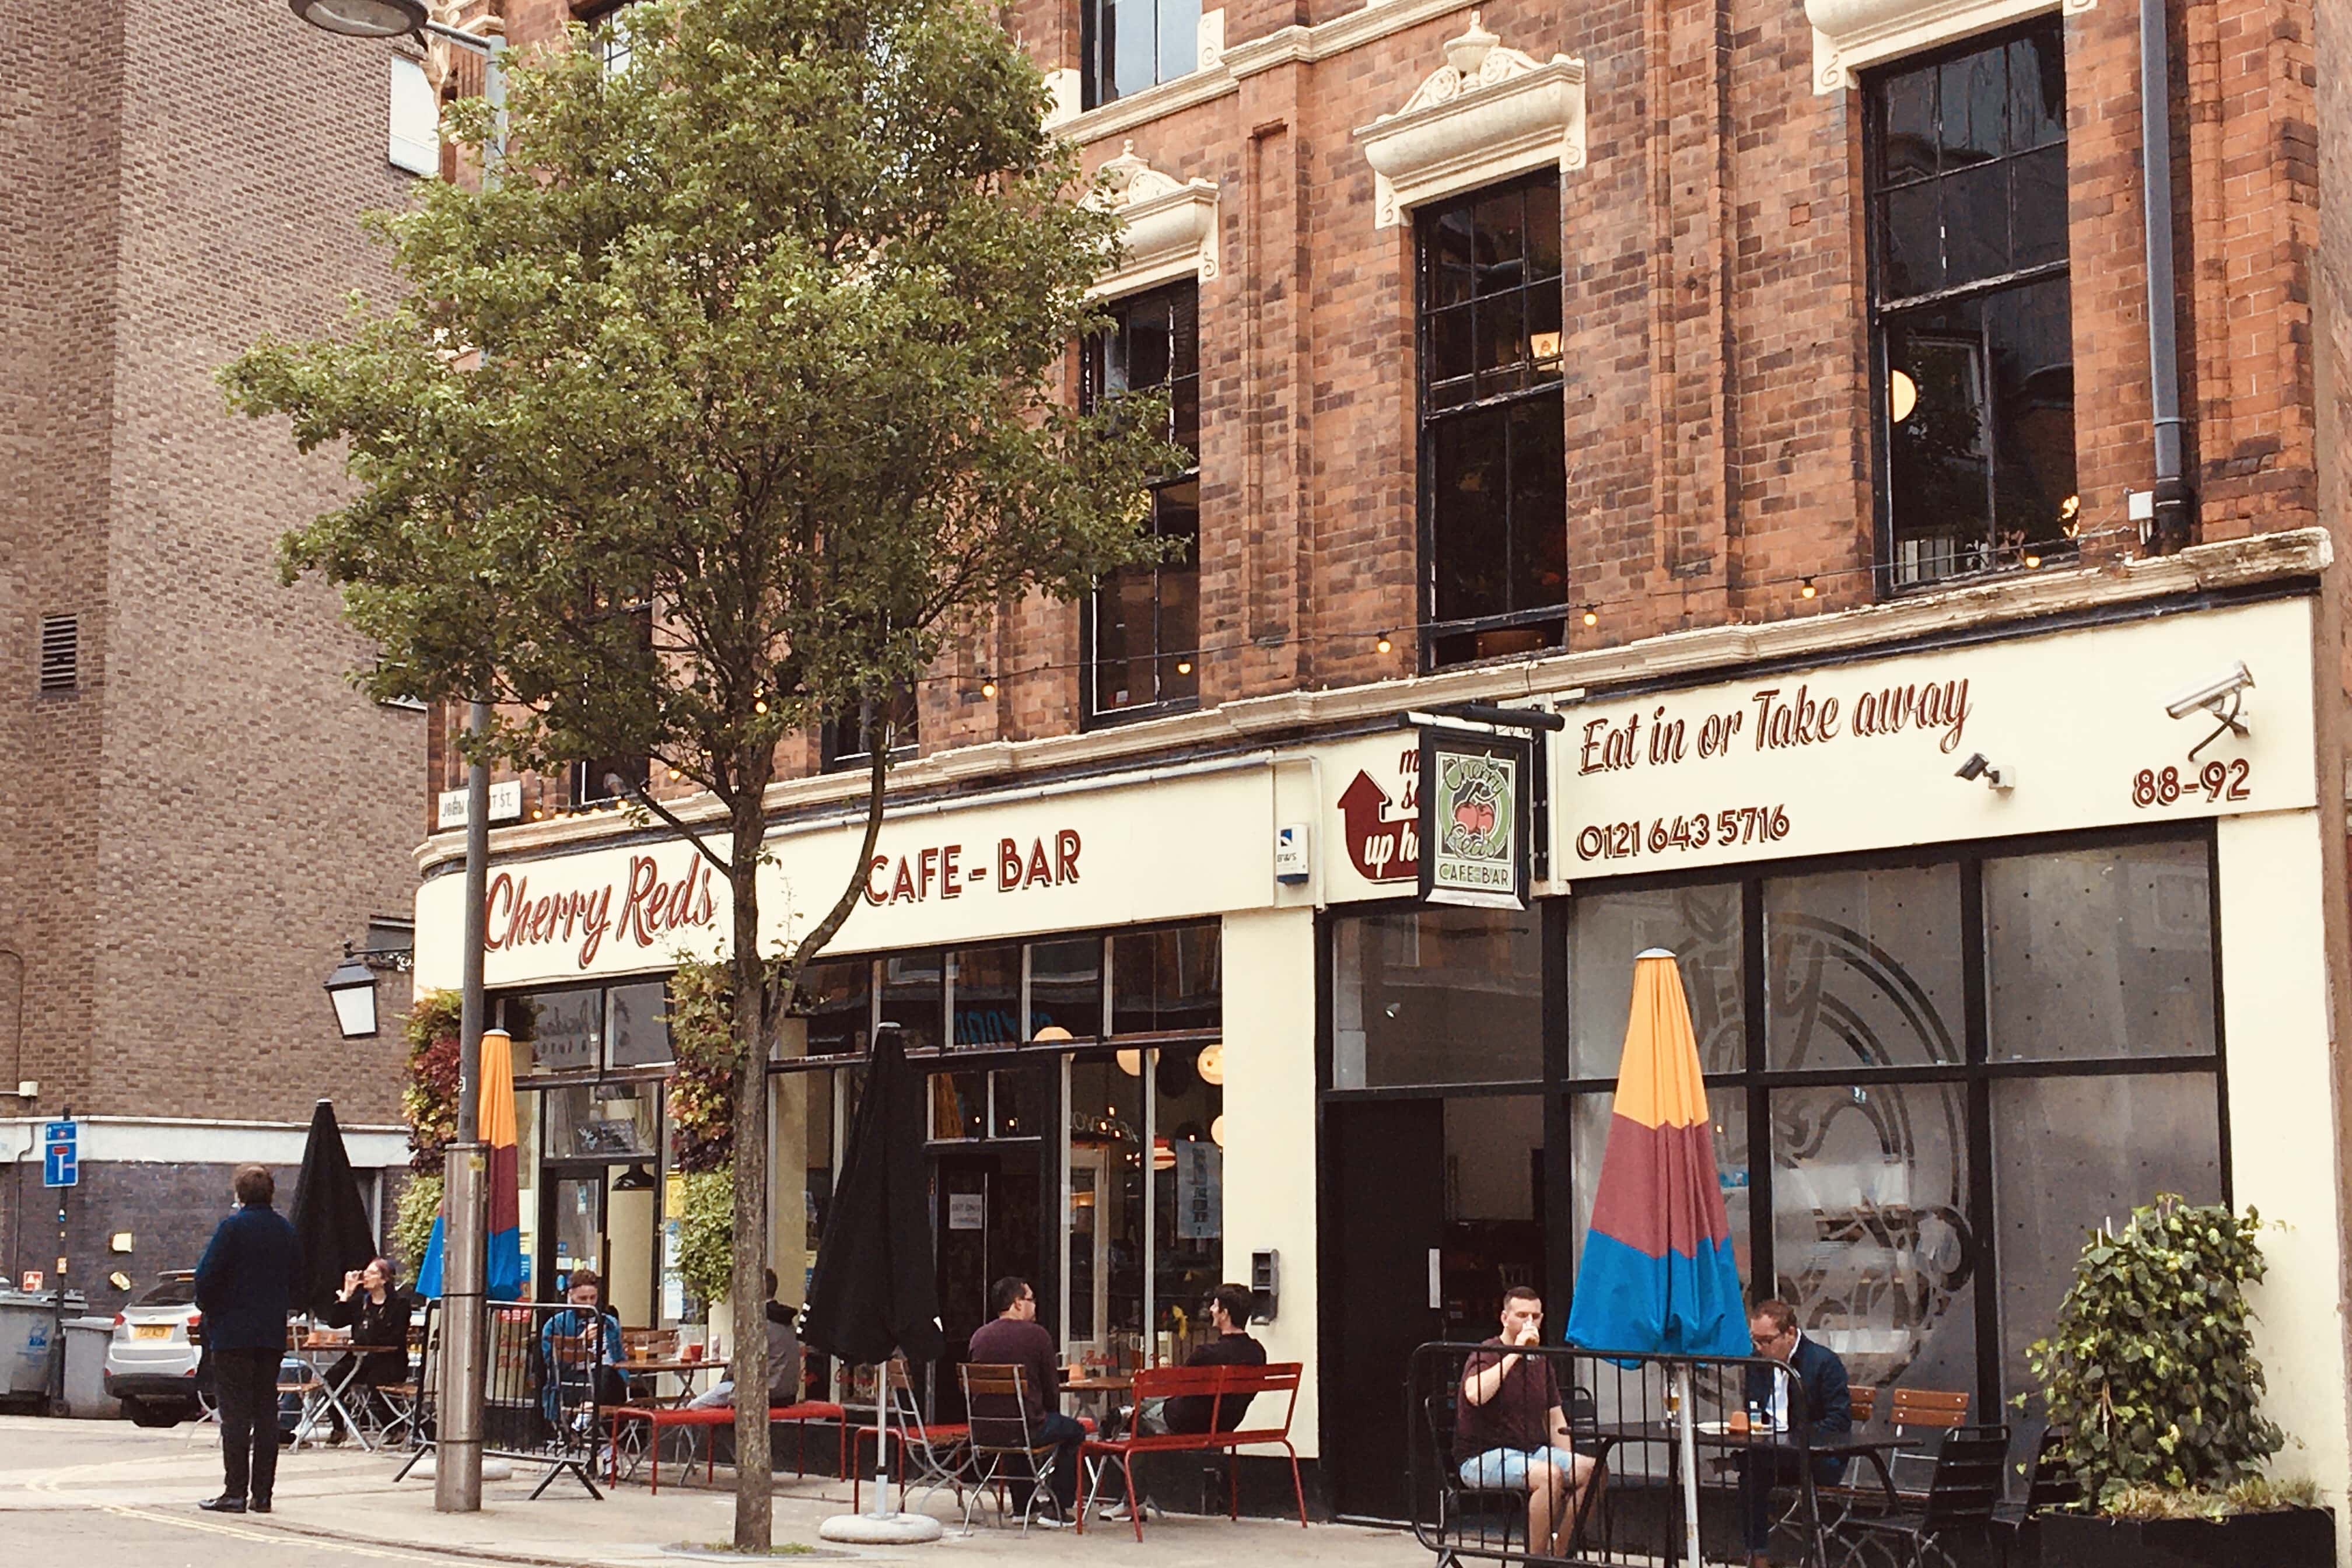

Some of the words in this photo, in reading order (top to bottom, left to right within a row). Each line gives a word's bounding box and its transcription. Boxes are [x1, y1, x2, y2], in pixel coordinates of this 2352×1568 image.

[1577, 713, 1641, 776] Eat
[1649, 706, 1689, 765] in
[1698, 710, 1743, 759] or
[1752, 684, 1842, 752] Take
[1853, 678, 1973, 754] away
[1443, 756, 1503, 803] Cherry
[2132, 758, 2250, 808] 88-92
[1364, 834, 1394, 878] up
[1446, 822, 1496, 859] Reds
[1576, 820, 1640, 861] 0121
[1648, 814, 1710, 853] 643
[1717, 804, 1791, 846] 5716
[484, 872, 612, 970] Cherry
[615, 852, 713, 948] Reds
